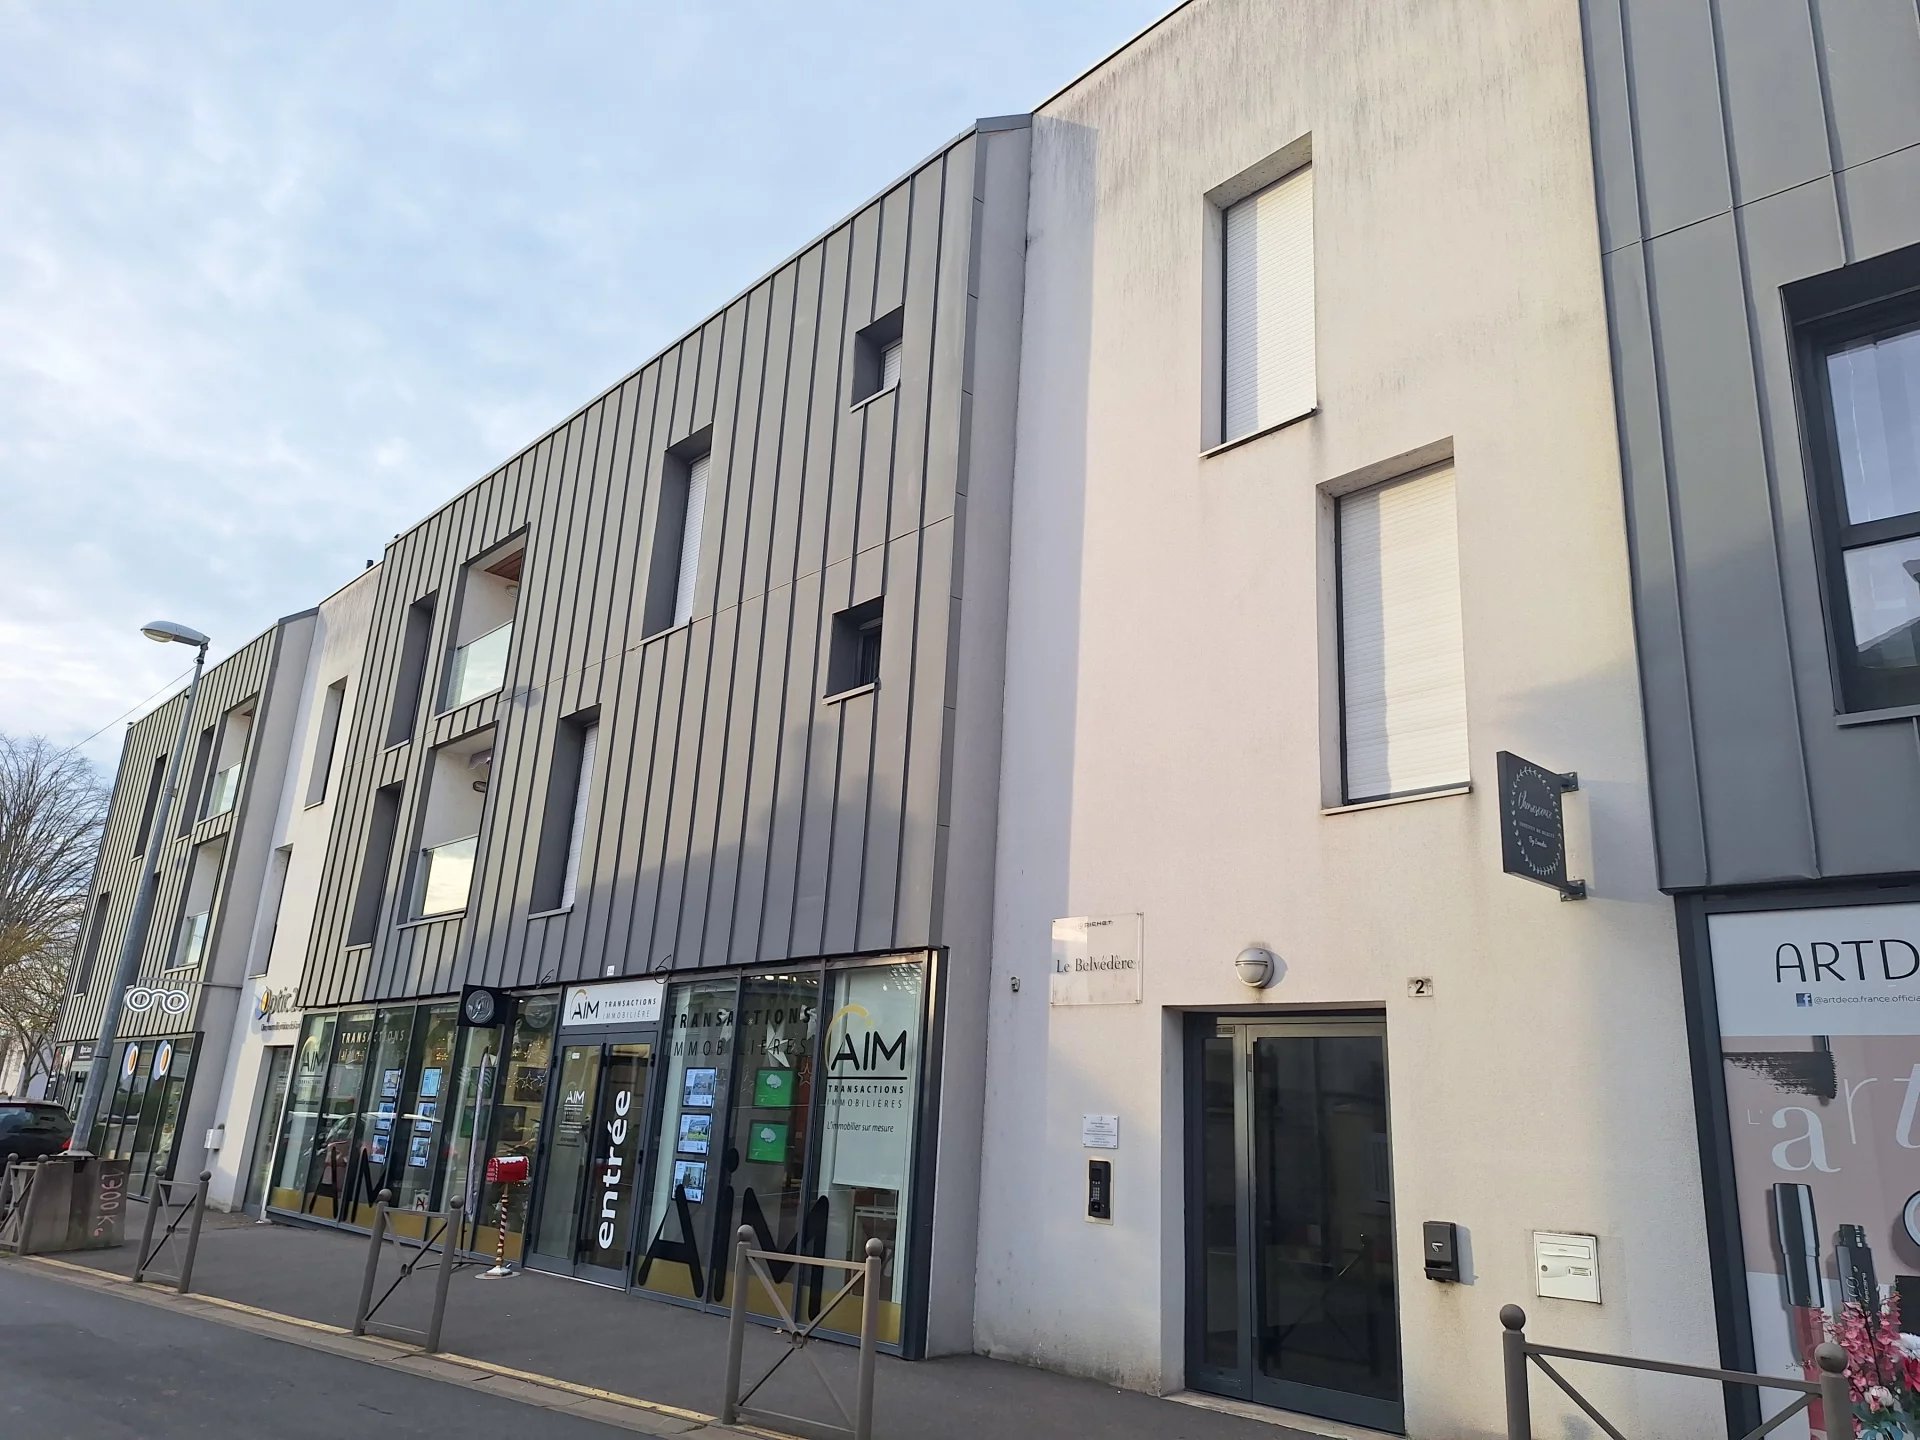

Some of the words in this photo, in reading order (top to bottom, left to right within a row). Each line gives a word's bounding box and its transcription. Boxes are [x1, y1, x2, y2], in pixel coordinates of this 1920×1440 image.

[1056, 959, 1071, 973] Le
[1775, 938, 1920, 983] ARTD
[1415, 979, 1425, 994] 2
[571, 1000, 600, 1020] AIM
[604, 997, 657, 1008] TRANSACTIONS
[830, 1029, 908, 1071] AIM
[828, 1084, 904, 1094] TRANSACTIONS
[861, 1124, 872, 1132] sur
[872, 1124, 895, 1133] mesure
[598, 1090, 631, 1249] entrée
